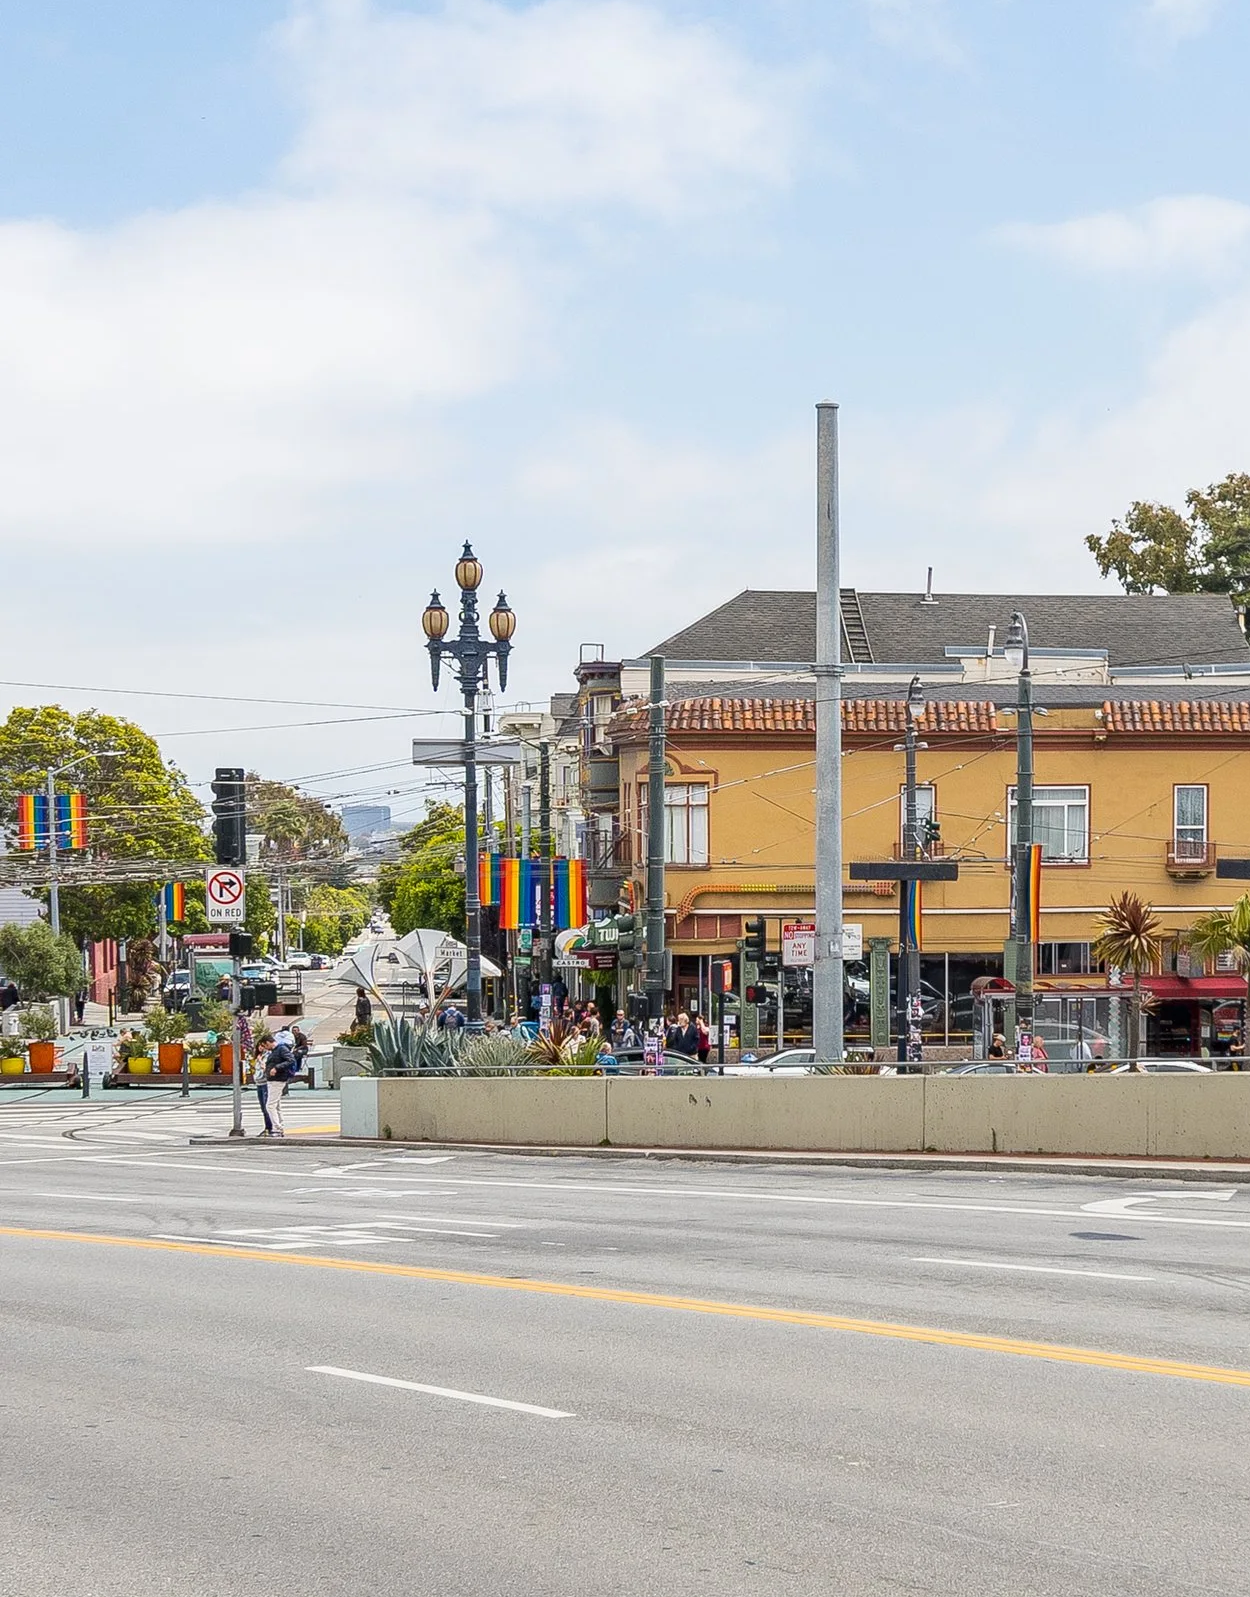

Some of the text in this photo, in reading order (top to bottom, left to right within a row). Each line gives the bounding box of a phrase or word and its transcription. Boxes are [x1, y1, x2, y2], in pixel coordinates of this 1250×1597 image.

[210, 908, 242, 917] ON RED
[598, 928, 619, 941] TWI
[784, 931, 793, 939] NO
[791, 949, 808, 957] TIME
